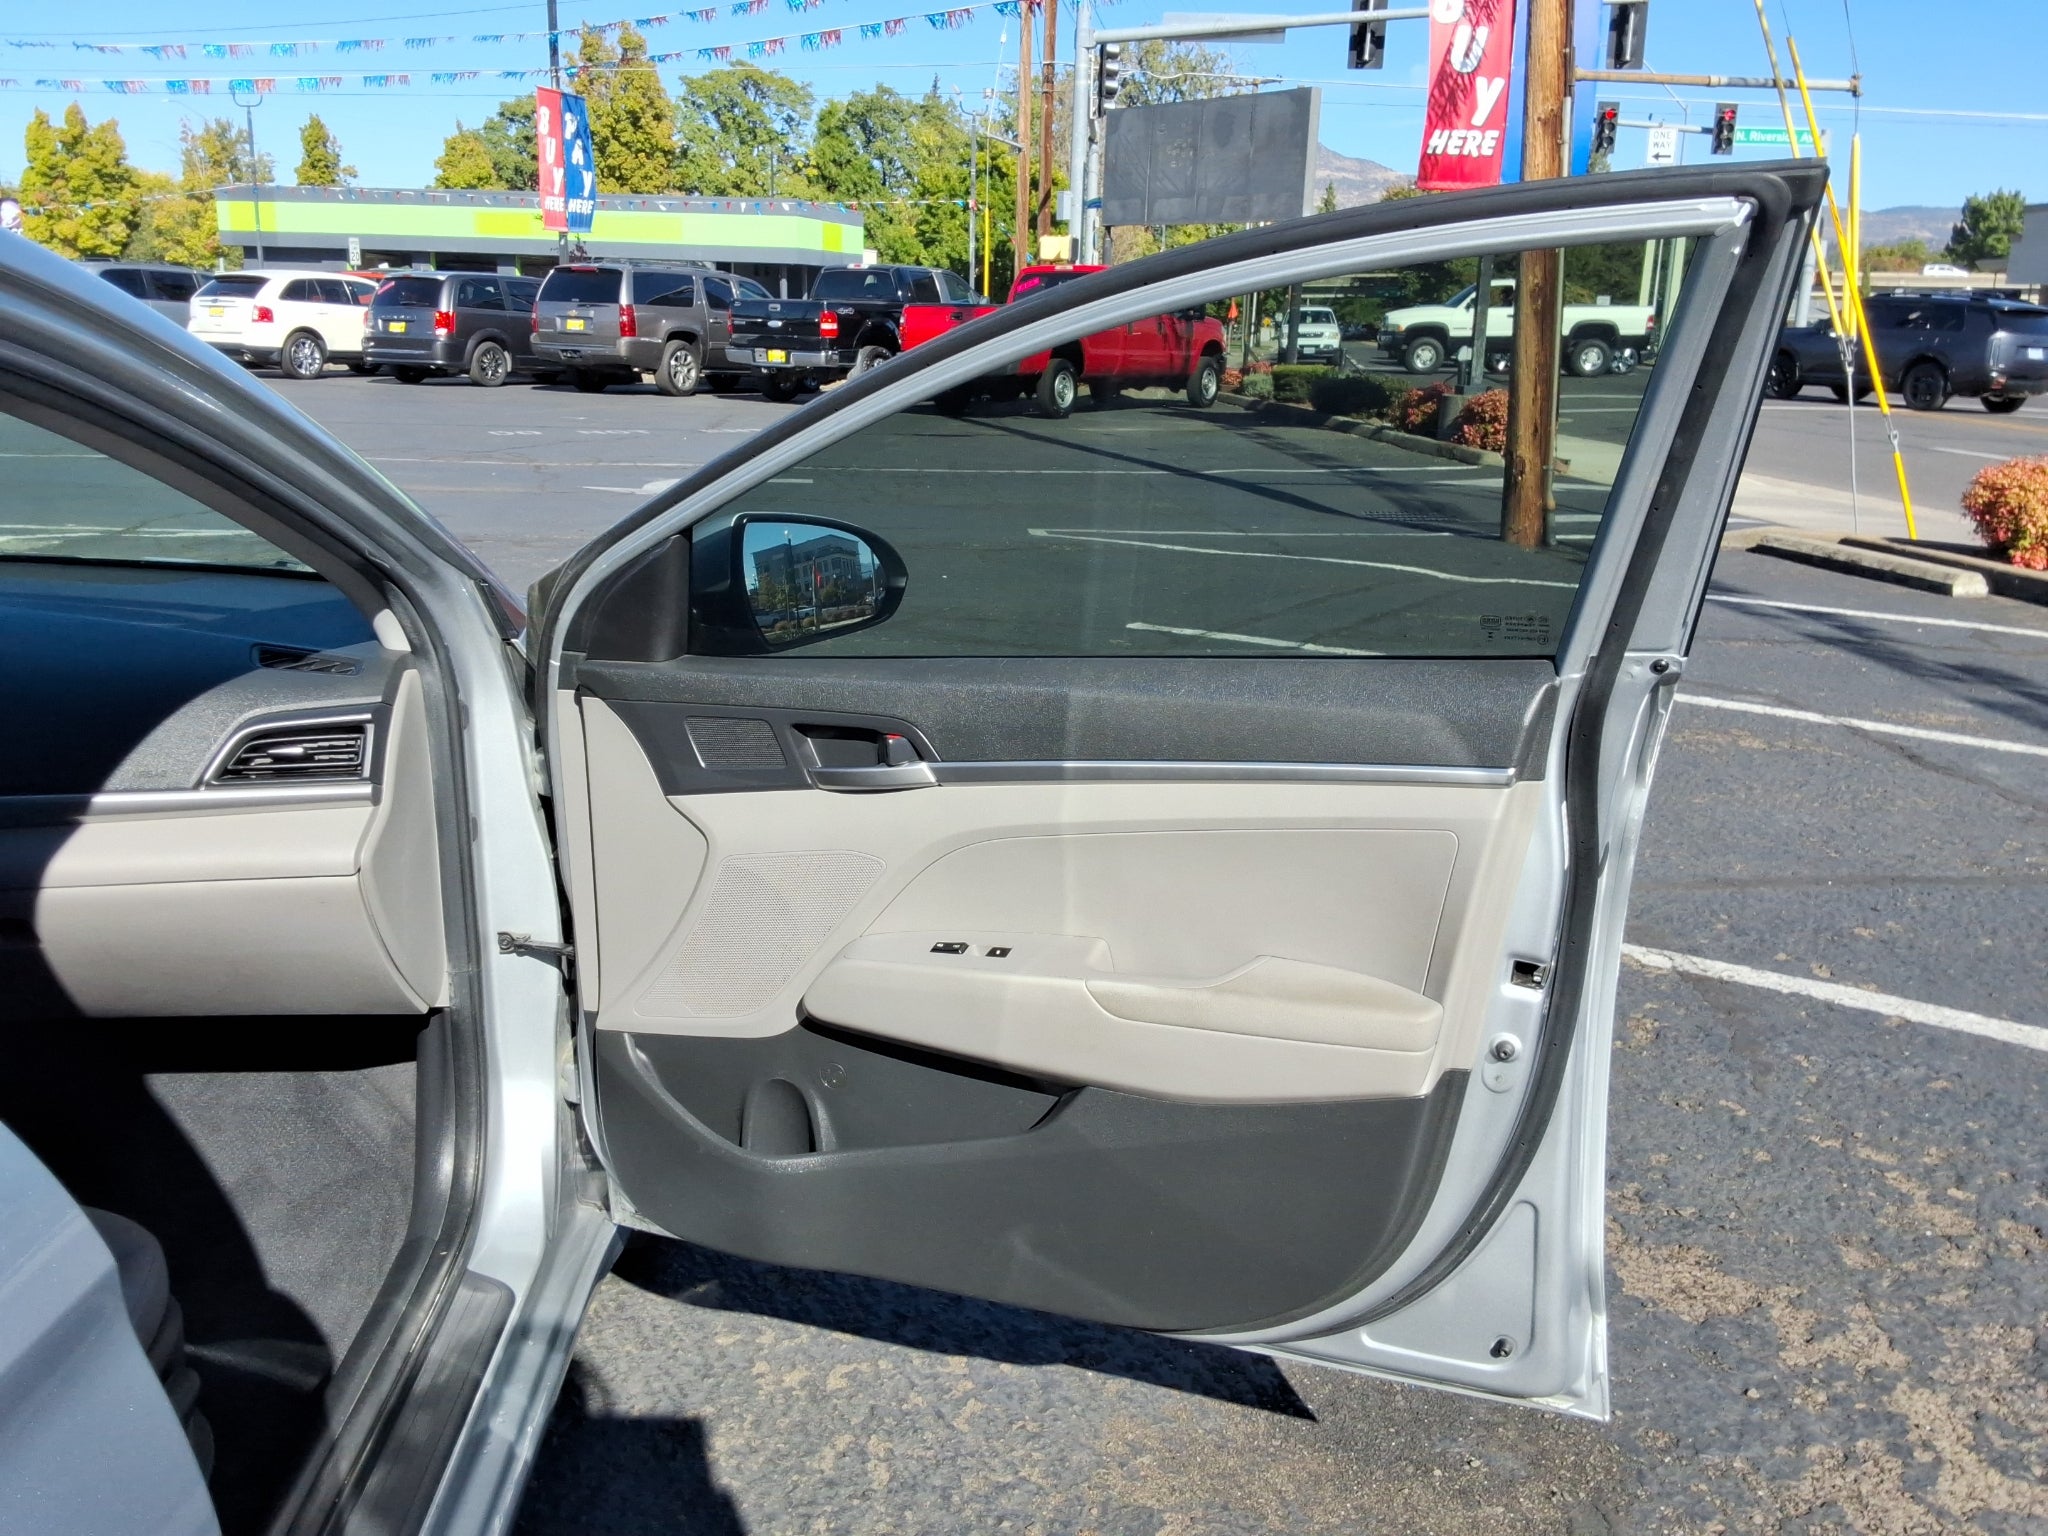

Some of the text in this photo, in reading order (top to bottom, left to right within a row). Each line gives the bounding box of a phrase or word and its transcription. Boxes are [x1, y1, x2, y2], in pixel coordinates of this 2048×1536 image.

[1426, 128, 1501, 158] HERE
[1653, 130, 1672, 140] ONE
[1750, 130, 1790, 142] Riversi
[539, 106, 564, 195] BUY
[1653, 140, 1671, 149] WAY
[564, 112, 592, 198] PAY
[544, 196, 565, 213] HERE
[567, 197, 595, 215] HERE
[351, 251, 360, 261] 20
